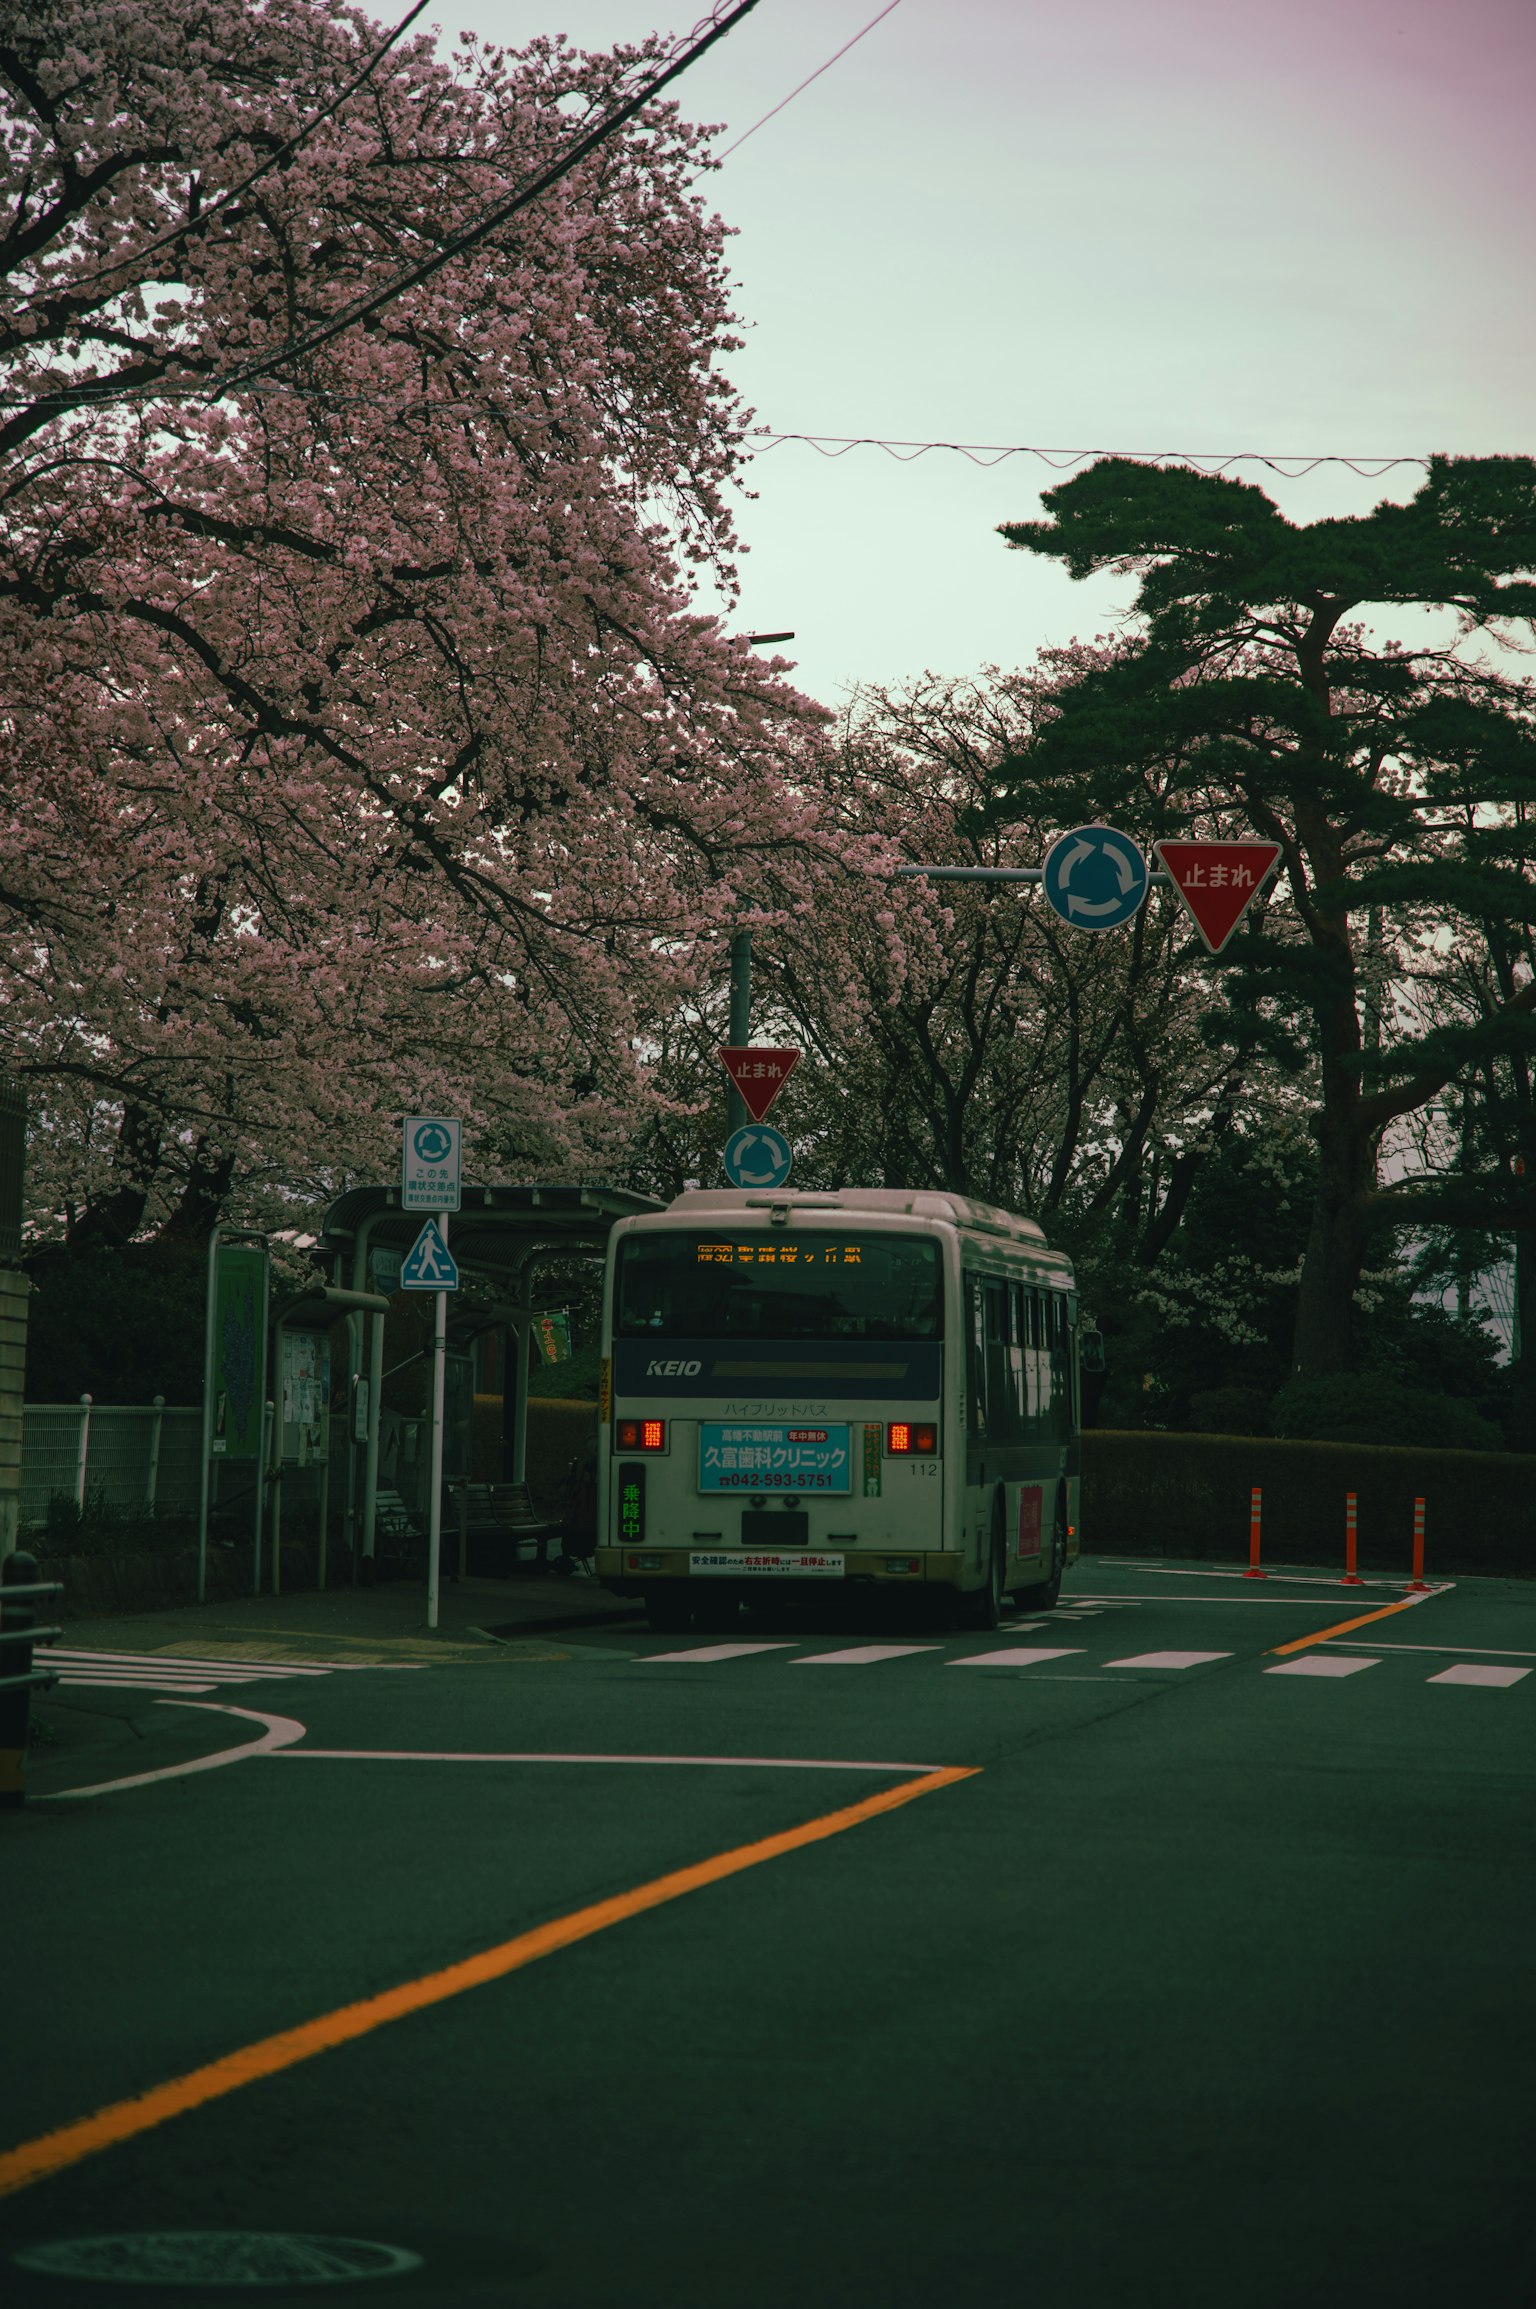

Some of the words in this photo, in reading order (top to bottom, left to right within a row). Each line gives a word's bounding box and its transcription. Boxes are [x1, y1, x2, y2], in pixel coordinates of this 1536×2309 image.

[1182, 863, 1255, 889] 止まれ
[736, 1062, 783, 1079] 止まれ
[416, 1169, 449, 1179] この先
[408, 1181, 456, 1192] 環状交差点
[646, 1360, 702, 1376] KEIO
[725, 1403, 828, 1417] ハイブリッドバス
[721, 1429, 783, 1443] 高幡不動駅前
[788, 1431, 827, 1442] 年中無休
[704, 1445, 847, 1469] 久富歯科クリニック
[910, 1464, 937, 1476] 112
[731, 1473, 833, 1487] 042-593-5751
[622, 1483, 641, 1538] 乗降中
